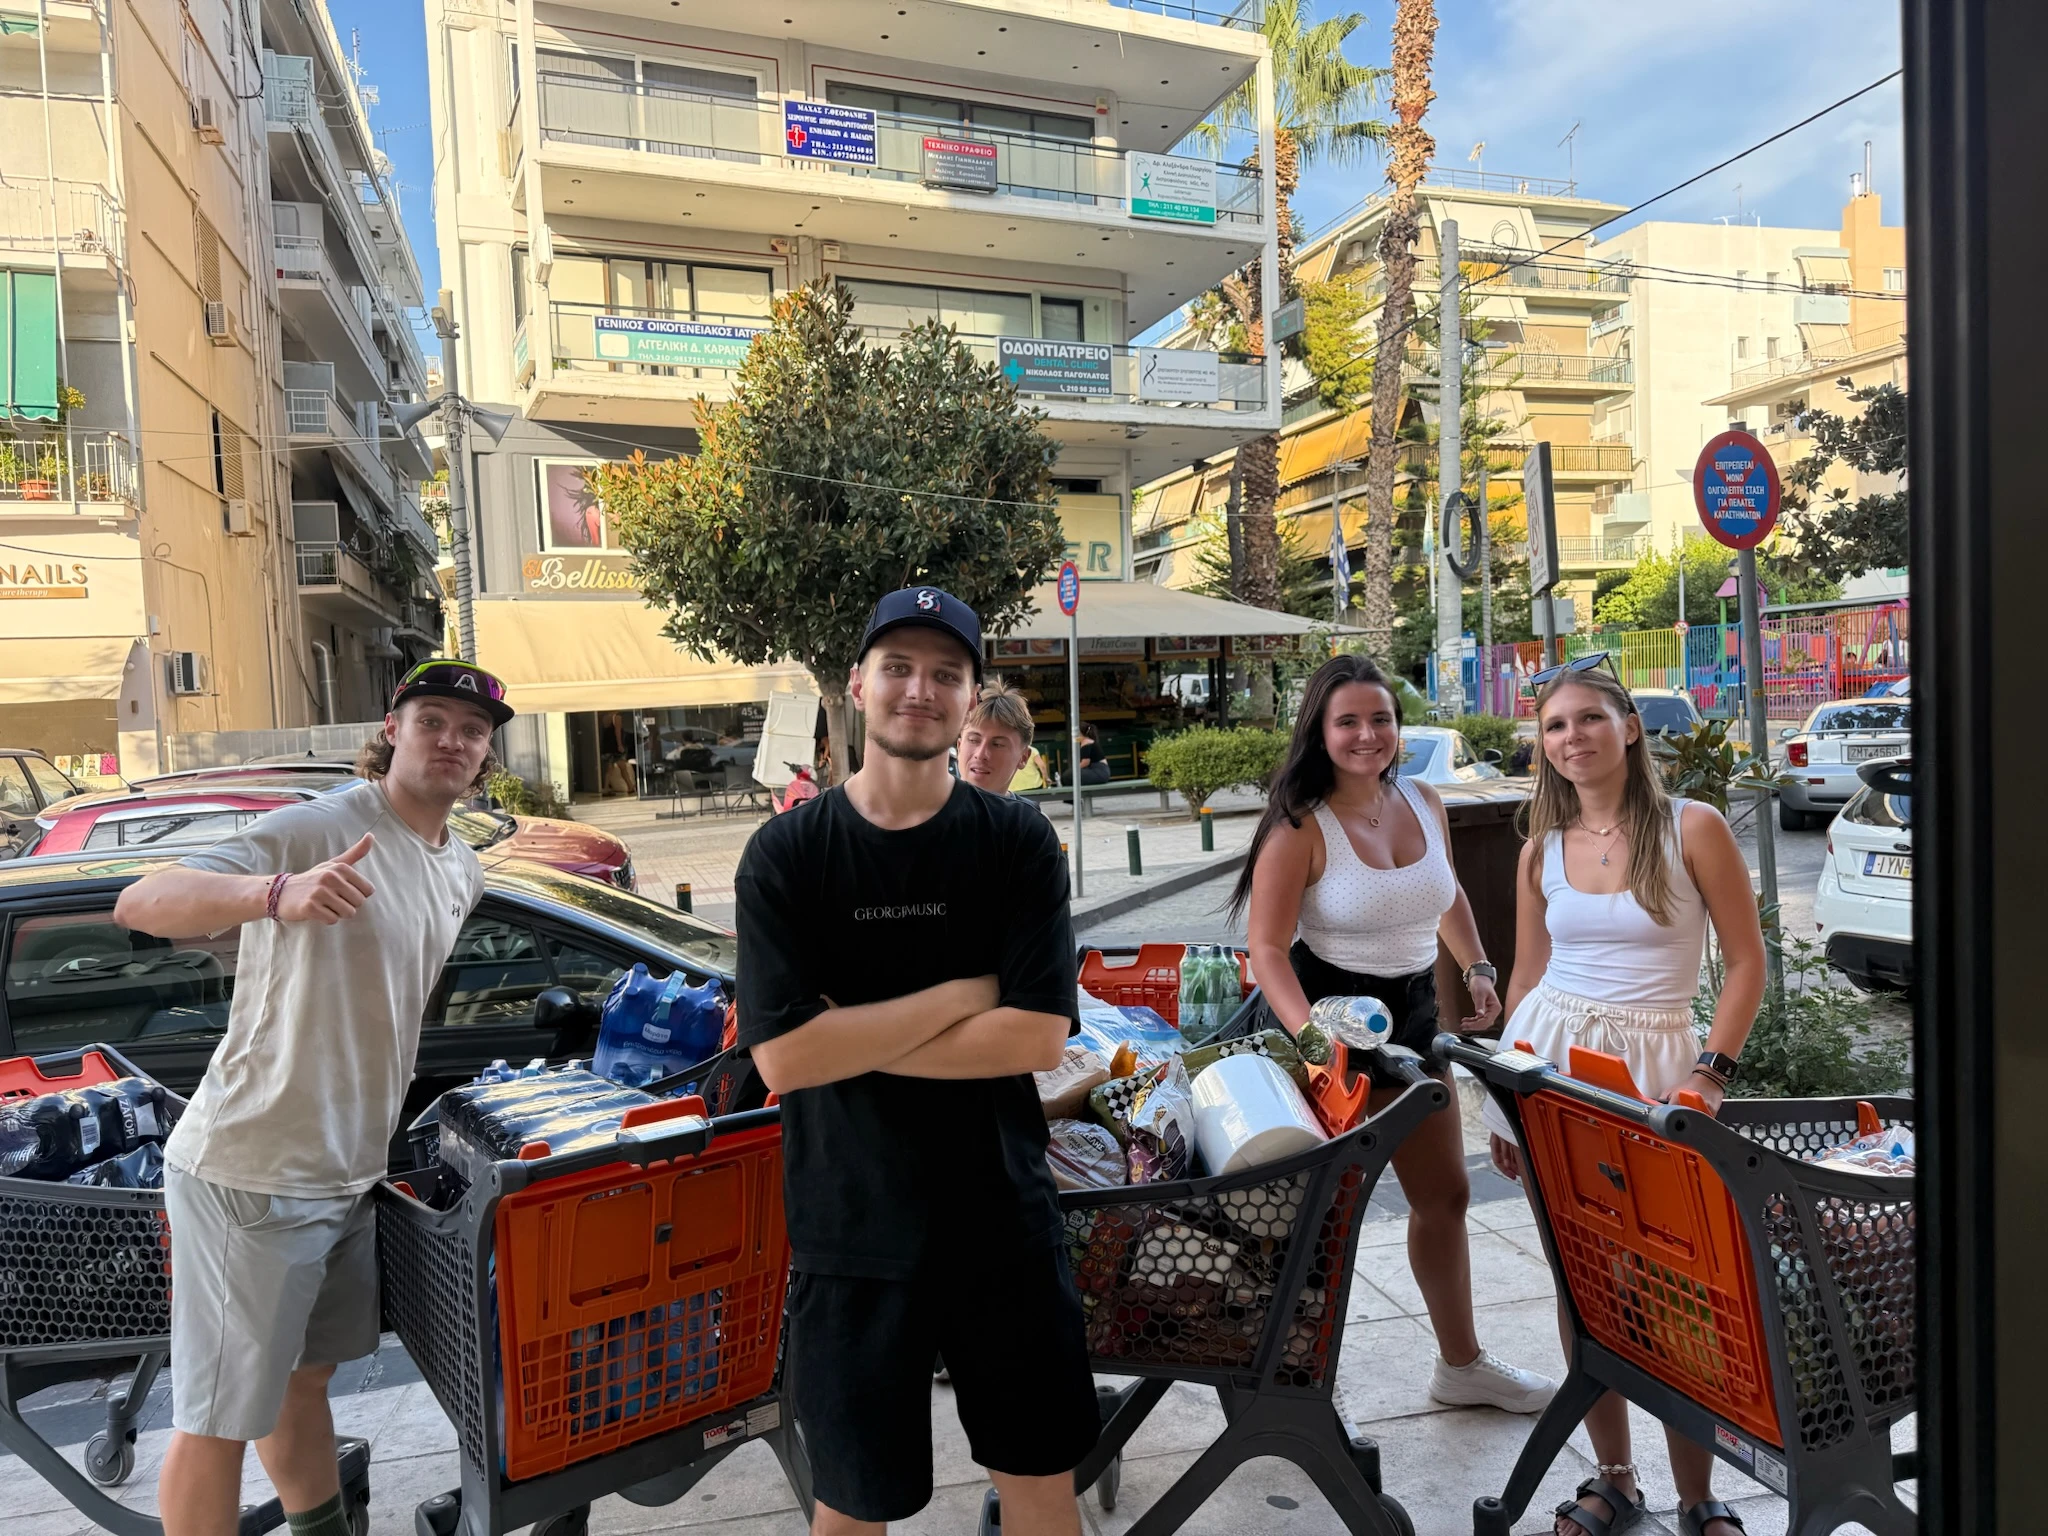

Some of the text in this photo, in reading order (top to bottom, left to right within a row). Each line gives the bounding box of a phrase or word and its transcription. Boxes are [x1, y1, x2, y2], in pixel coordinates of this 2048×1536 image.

[927, 140, 992, 156] ΤΕΧΝΙΚΟ ΓΡΑΦΕΙΟ
[598, 318, 644, 331] ΓΕΝΙΚΟΣ
[647, 322, 732, 337] ΟΙΚΟΓΕΝΕΙΑΚΟΣ
[638, 339, 687, 352] ΑΓΓΕΛΙΚΗ
[690, 343, 701, 353] Δ.
[1002, 341, 1109, 360] ΟΔΟΝΤΙΑΤΡΕΙΟ
[1034, 358, 1098, 369] DENTAL CLINIC
[1026, 369, 1109, 380] ΝΙΚΟΛΑΟΣ ΠΑΓΟΥΛΑΤΟΣ
[1715, 461, 1754, 470] ΕΠΙΤΡΕΠΕΤΑΙ
[1726, 473, 1744, 483] ΜΟΝΟ
[1707, 486, 1764, 495] ΟΛΙΓΟΛΕΠΤΗ ΣΤΑΣΗ
[1718, 499, 1756, 507] ΓΙΑ ΠΕΛΑΤΕΣ
[1714, 511, 1761, 520] ΚΑΤΑΣΤΗΜΑΤΩΝ
[1061, 541, 1112, 572] ER
[0, 564, 88, 584] NAILS
[1851, 748, 1868, 757] ZMT
[120, 1099, 136, 1139] ΖΑΓΟΡΙ
